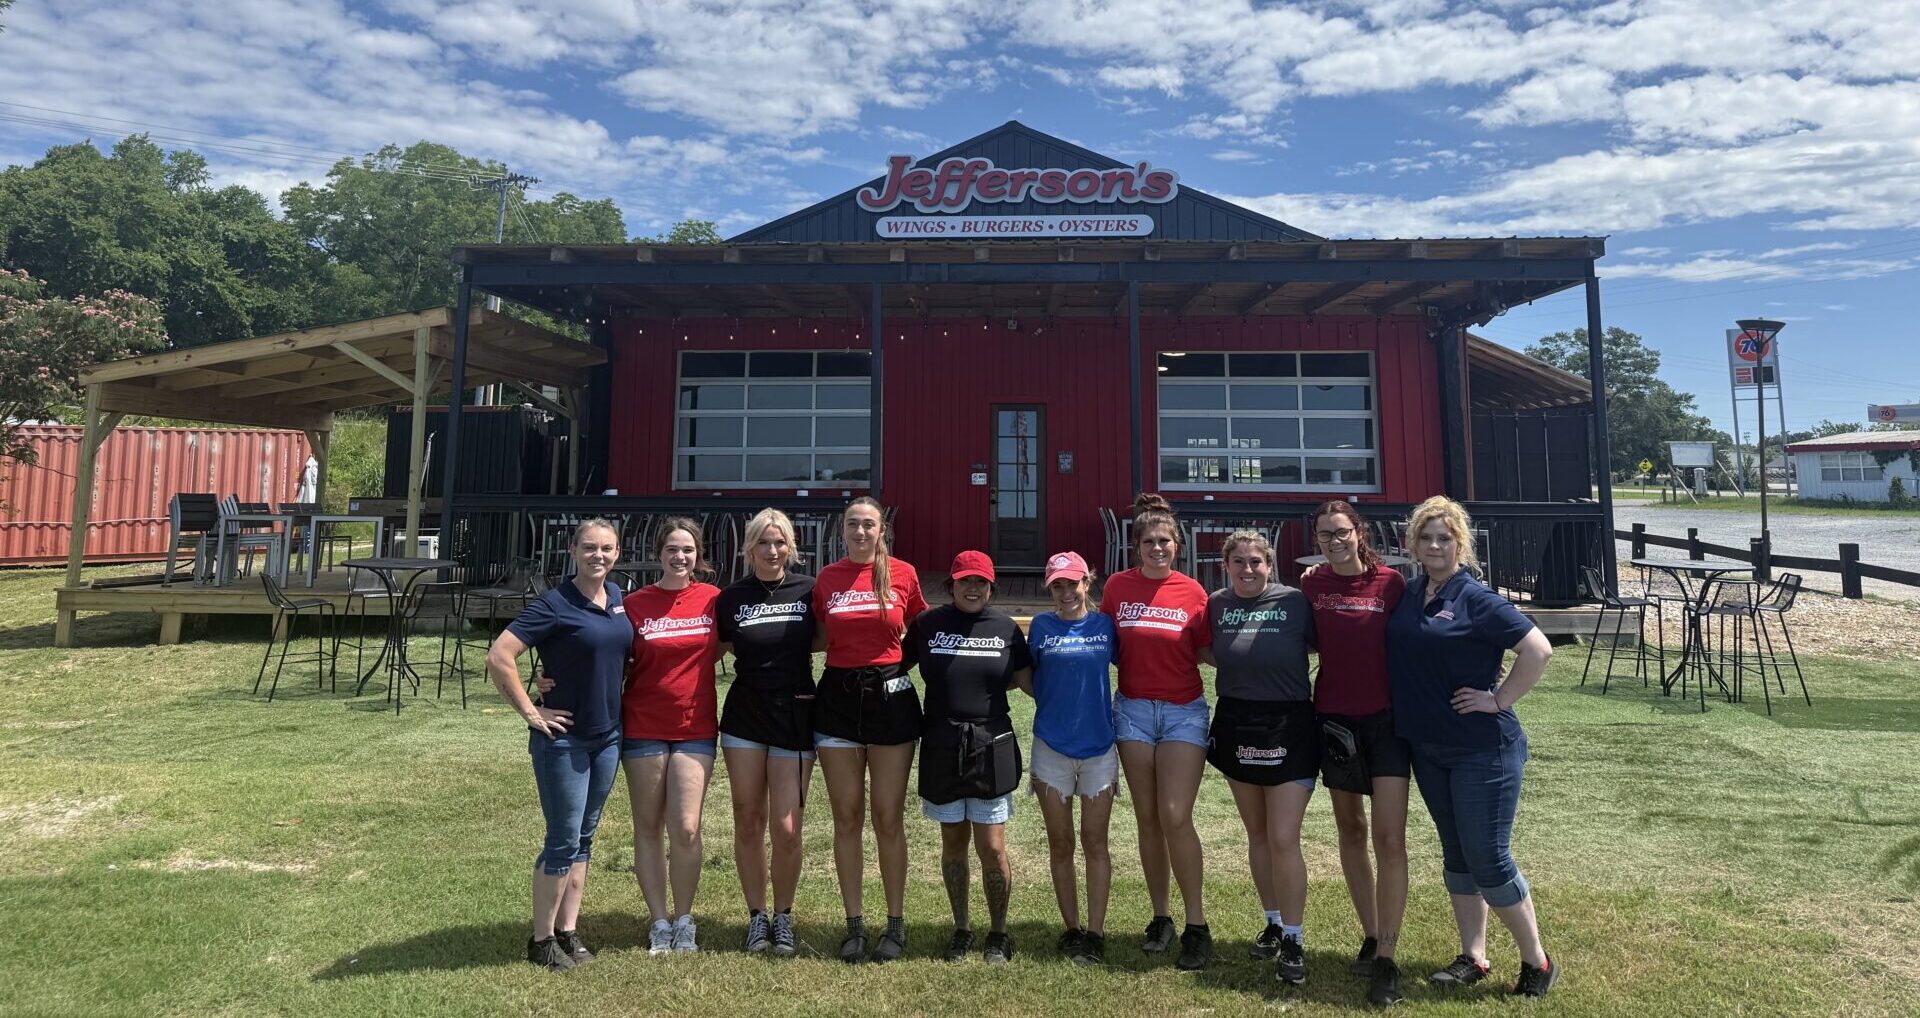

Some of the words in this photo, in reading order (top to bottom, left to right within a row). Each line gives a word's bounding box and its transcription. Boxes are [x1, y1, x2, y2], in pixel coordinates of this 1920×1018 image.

[859, 154, 1175, 208] Jefferson's
[886, 220, 946, 234] WINGS
[959, 219, 1044, 233] BURGERS
[1058, 218, 1139, 232] OYSTERS
[1880, 409, 1891, 417] 76
[827, 590, 897, 608] Jefferss
[734, 601, 806, 621] Jefferson's
[1117, 602, 1188, 622] Jefferson's
[1217, 606, 1287, 625] Jefferson's
[639, 614, 712, 634] Jefferson's
[928, 632, 1004, 648] Jefferson's
[1039, 633, 1108, 648] Jefferson's
[1236, 746, 1287, 759] Jefferson's
